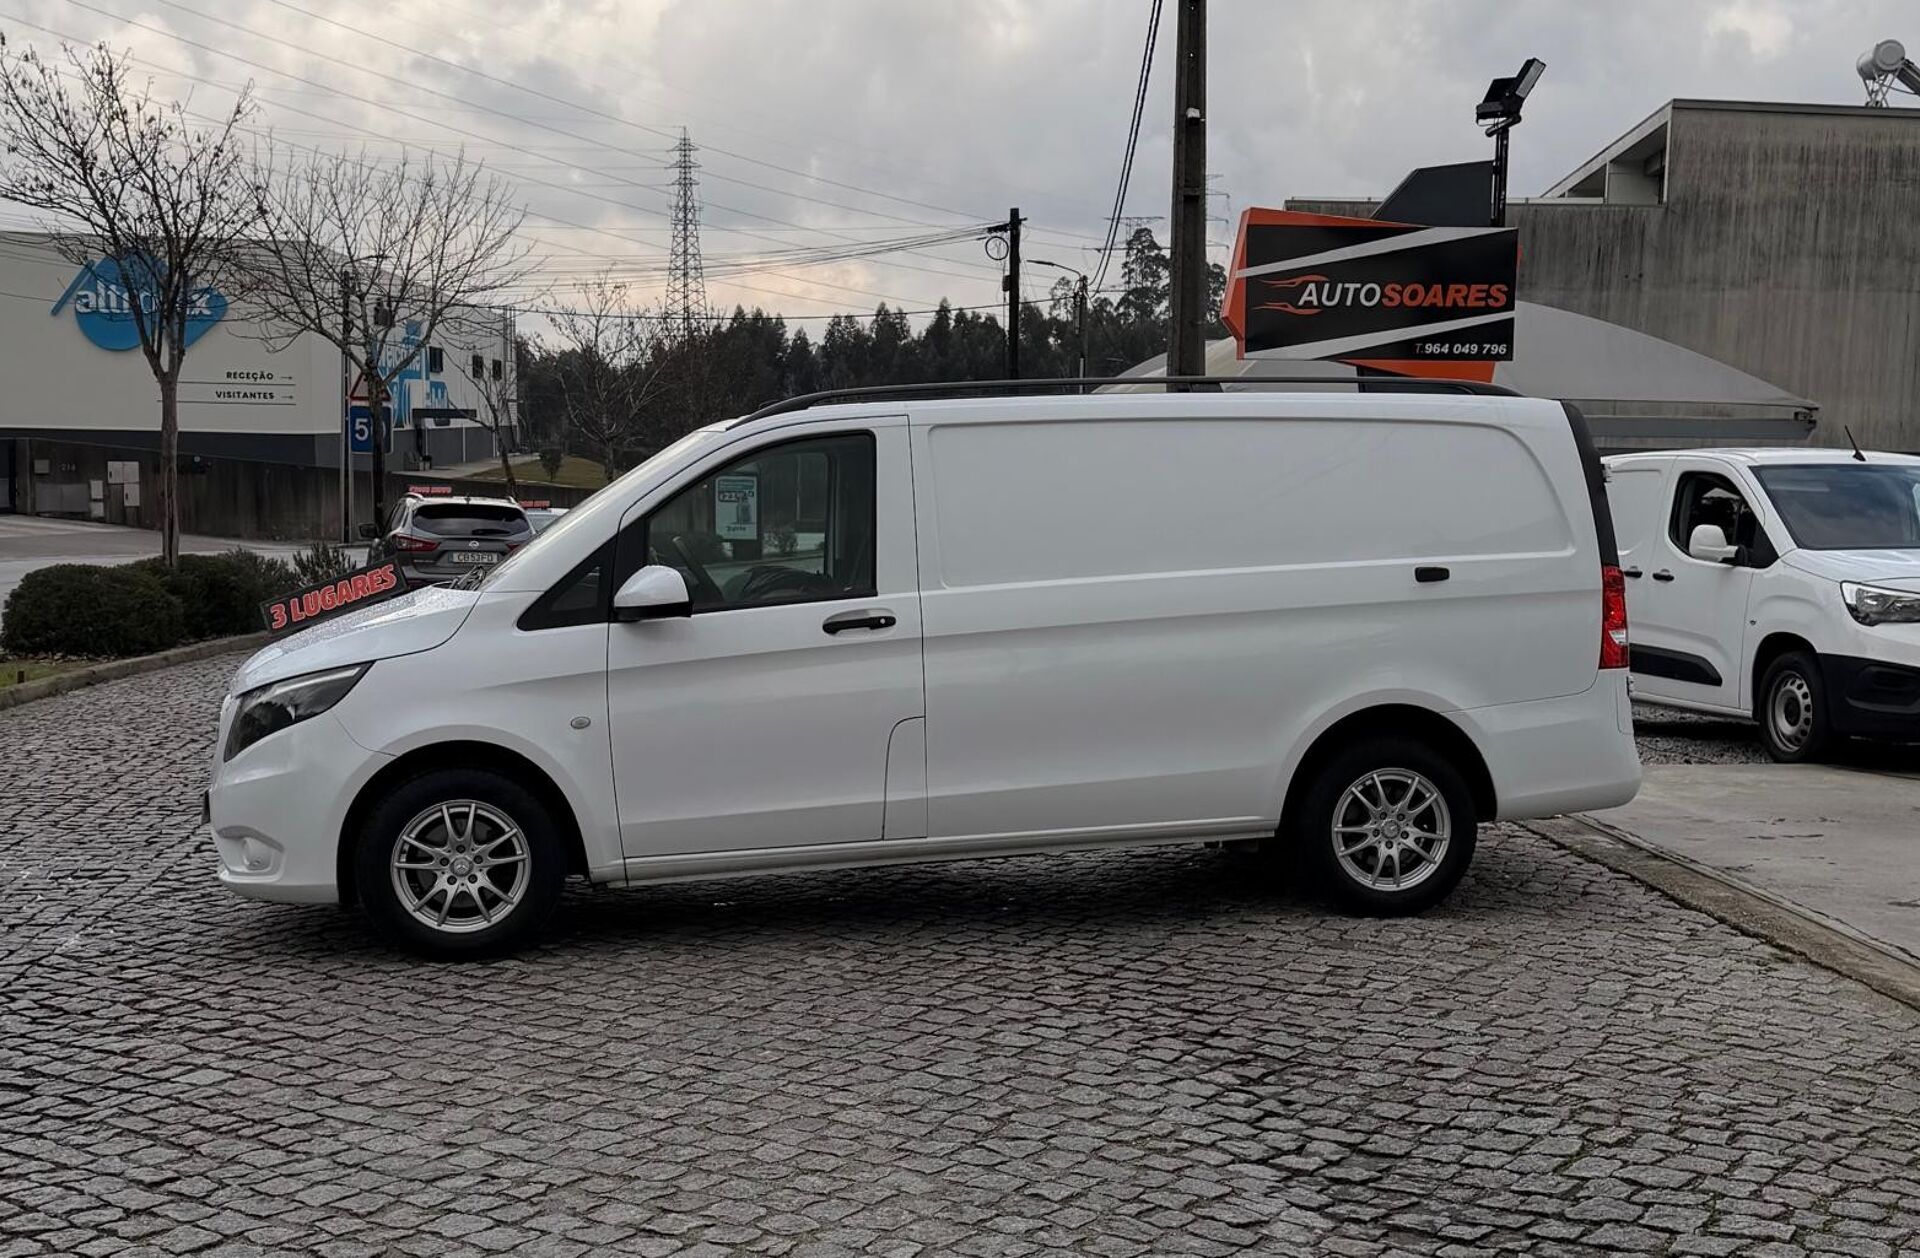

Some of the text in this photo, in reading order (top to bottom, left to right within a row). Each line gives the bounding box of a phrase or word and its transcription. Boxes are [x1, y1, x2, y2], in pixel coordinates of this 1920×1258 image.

[1453, 343, 1478, 354] 049
[1482, 343, 1507, 354] 796
[226, 371, 274, 382] RECEÇÃO
[215, 390, 275, 400] VISITANTES
[270, 564, 397, 629] 3 LUGARES
